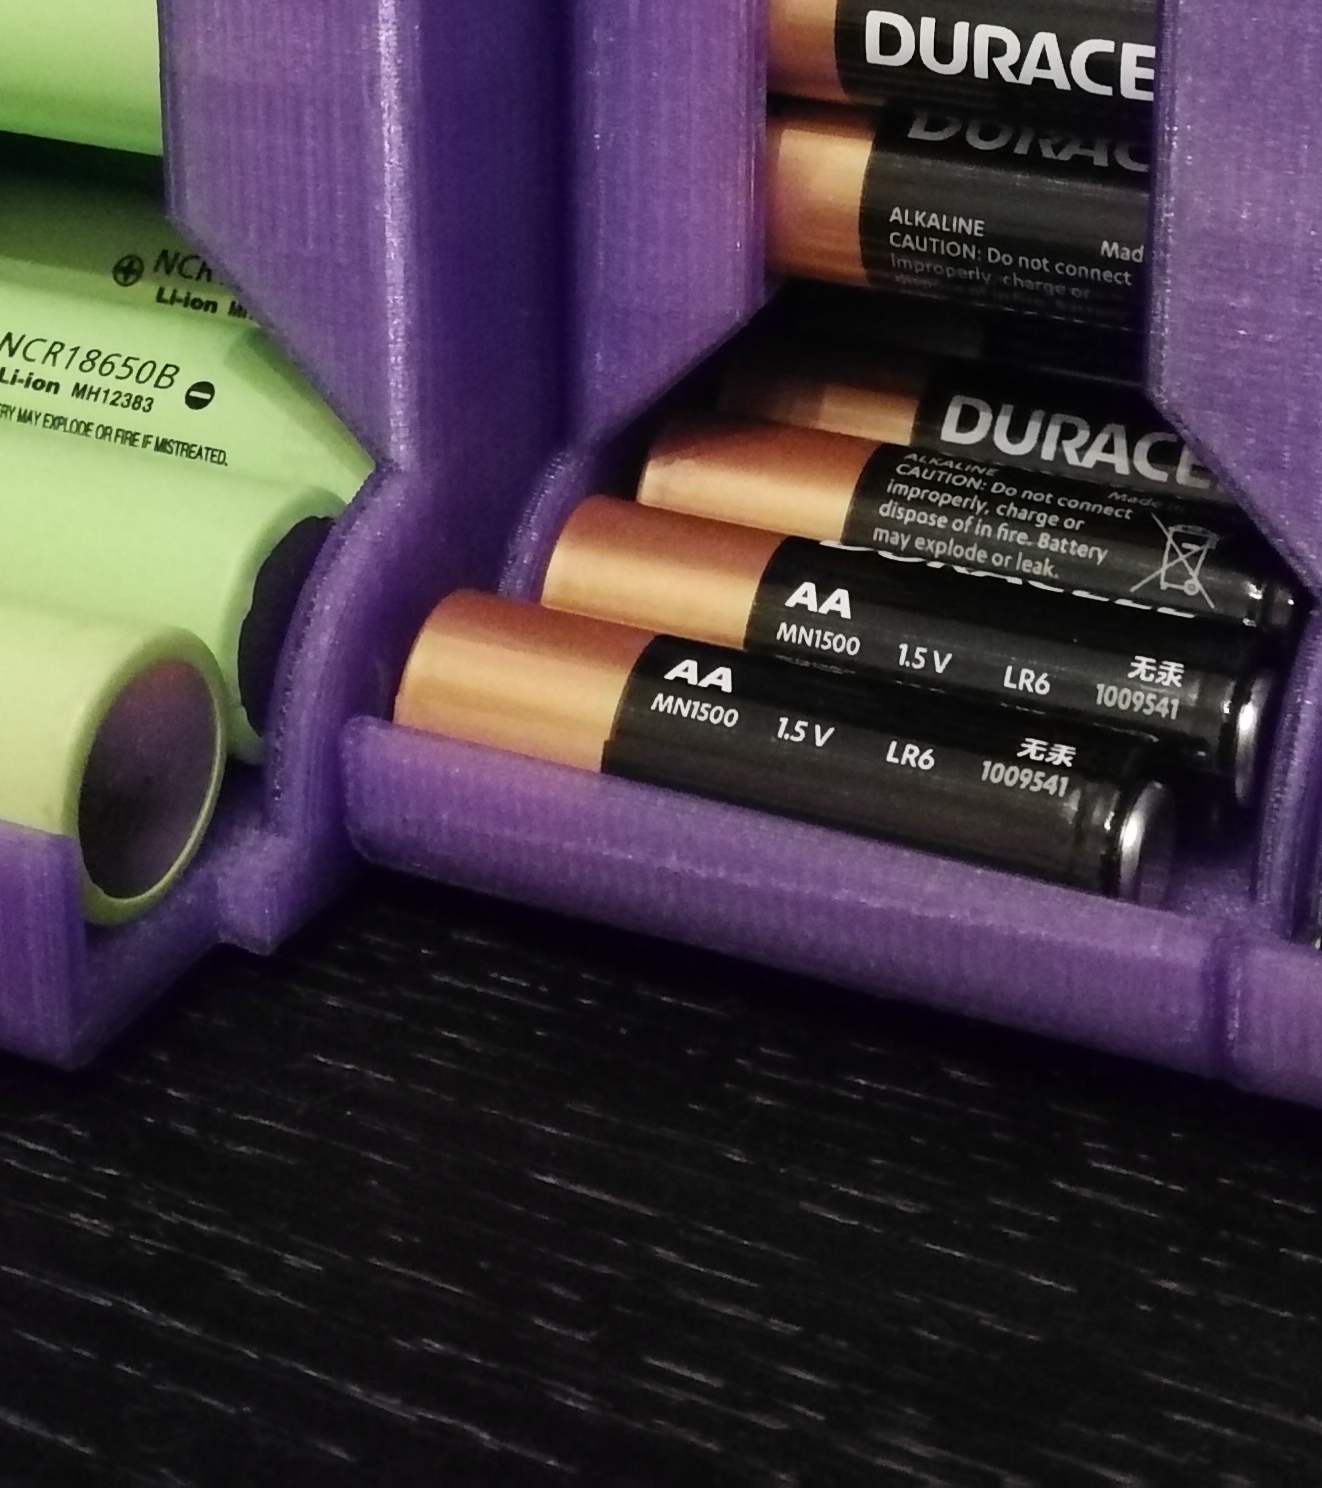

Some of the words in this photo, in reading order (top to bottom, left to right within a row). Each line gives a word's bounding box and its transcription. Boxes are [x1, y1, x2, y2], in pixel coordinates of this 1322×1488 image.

[865, 10, 1157, 101] DURACE
[889, 206, 985, 237] ALKALINE
[889, 231, 982, 261] CAUTION:
[987, 247, 1014, 266] Do
[1018, 254, 1050, 274] not
[1055, 260, 1133, 287] connect
[1100, 240, 1145, 263] Mad
[156, 286, 218, 313] Li-ion
[71, 382, 155, 413] MH12383
[17, 407, 42, 426] MAY
[42, 413, 95, 437] EXPLODE
[95, 424, 113, 442] OR
[114, 428, 141, 447] FIRE
[141, 434, 154, 449] IF
[154, 436, 229, 467] MISTREATED.
[903, 453, 999, 477] ALKALINE
[886, 478, 990, 515] improperly,
[995, 501, 1060, 529] charge
[1063, 517, 1086, 531] or
[895, 463, 988, 491] CAUTION:
[990, 481, 1018, 498] Do
[1020, 489, 1054, 505] not
[1057, 496, 1134, 520] connect
[878, 499, 949, 529] dispose
[951, 515, 974, 534] of
[974, 518, 993, 538] in
[1037, 532, 1109, 567] Battery
[872, 527, 912, 551] may
[914, 536, 988, 564] explode
[991, 552, 1013, 568] or
[1015, 551, 1059, 579] leak.
[784, 581, 852, 619] AA
[663, 659, 733, 693] AA
[776, 622, 861, 656] MN1500
[1003, 665, 1051, 695] LR6
[1127, 655, 1185, 687] 无汞
[1096, 683, 1180, 720] 1009541
[650, 693, 739, 727] MN1500
[885, 740, 935, 771] LR6
[1016, 737, 1077, 767] 无汞
[981, 760, 1070, 798] 1009541
